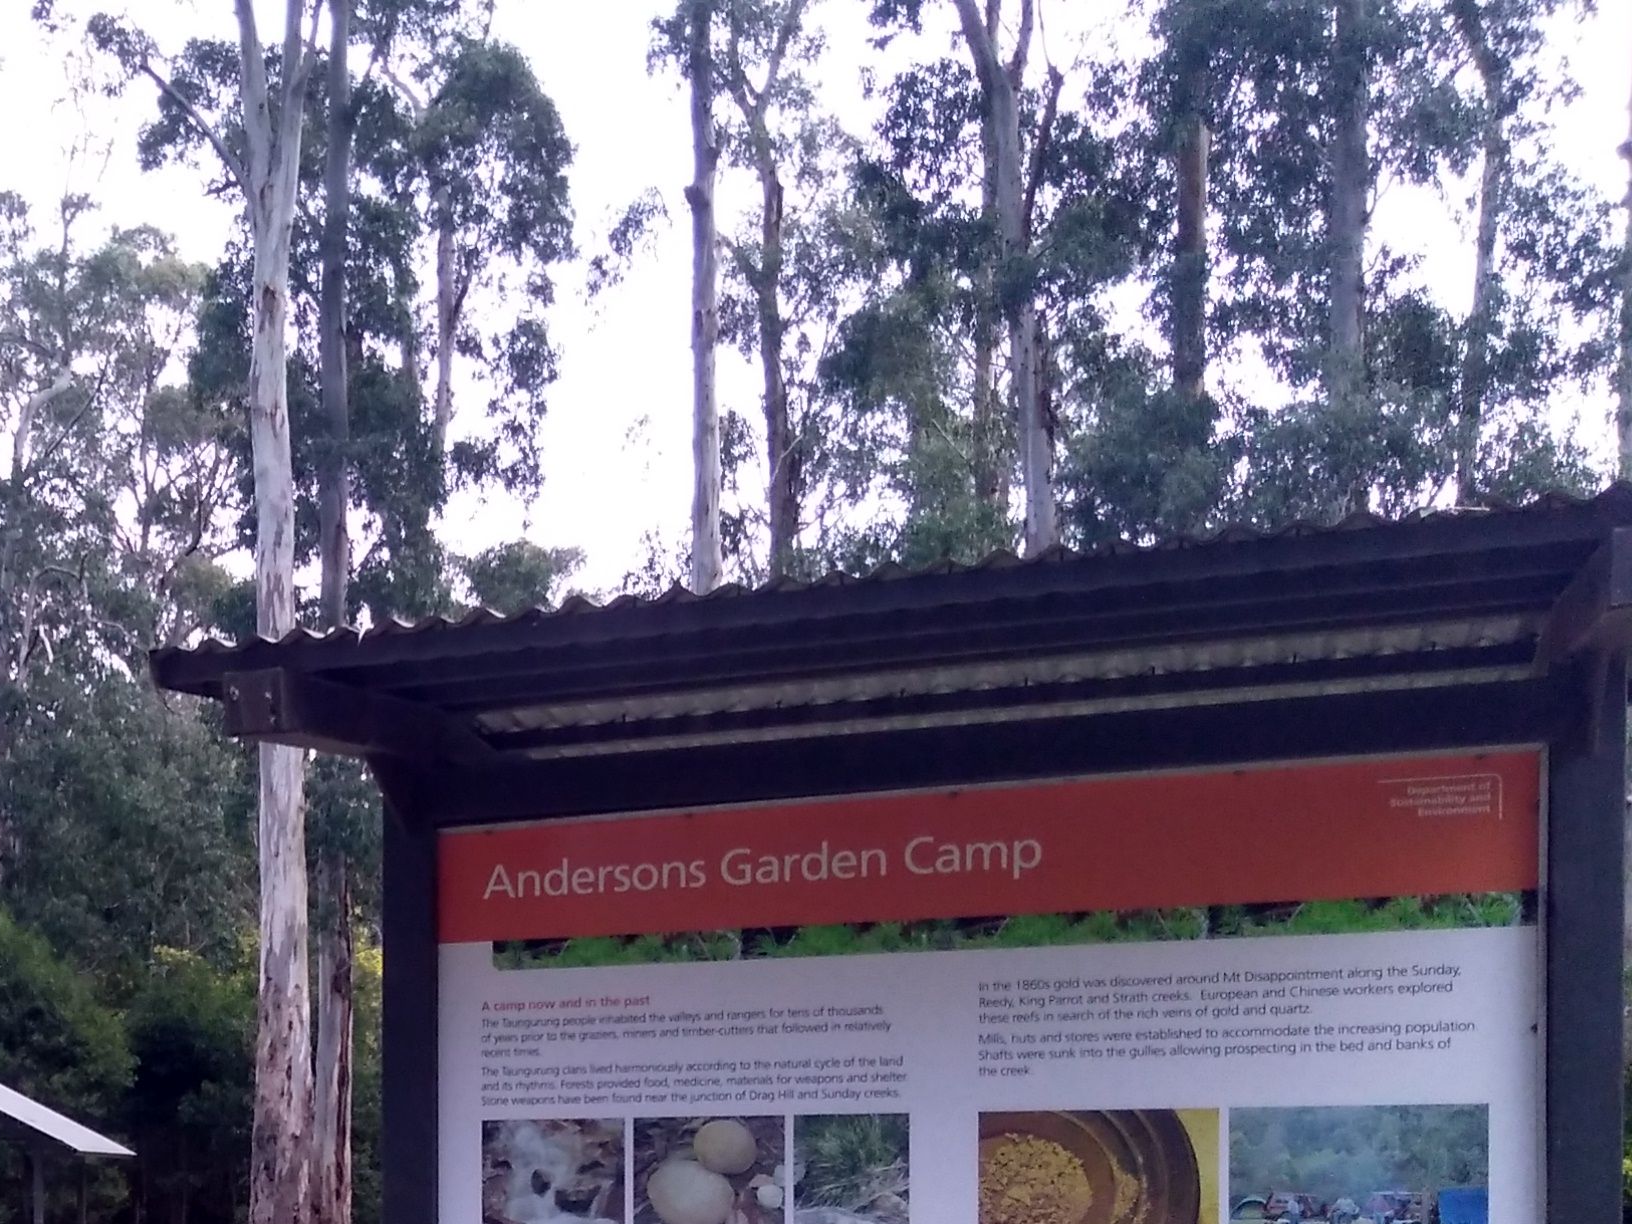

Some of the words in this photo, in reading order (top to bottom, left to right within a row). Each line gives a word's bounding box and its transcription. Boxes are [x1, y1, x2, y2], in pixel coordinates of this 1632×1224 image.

[483, 859, 706, 899] Andersons
[721, 842, 887, 885] Garden
[905, 836, 1042, 878] Camp
[993, 979, 1010, 991] the
[1017, 978, 1050, 990] 1860s
[1053, 977, 1079, 992] gold
[1083, 979, 1107, 988] was
[1110, 974, 1172, 987] discovered
[1176, 973, 1219, 985] around
[1224, 972, 1240, 983] Mt
[1245, 969, 1343, 986] Disappointment
[1347, 967, 1382, 983] along
[1388, 967, 1407, 978] the
[1019, 995, 1045, 1010] King
[1049, 994, 1082, 1005] Parrot
[1086, 993, 1109, 1004] and
[1113, 992, 1147, 1003] Strath
[1201, 988, 1258, 1004] European
[1263, 987, 1285, 999] and
[1290, 986, 1339, 998] Chinese
[1344, 984, 1394, 996] workers
[1398, 982, 1452, 998] explored
[980, 1012, 1009, 1023] these
[1013, 1011, 1040, 1022] reefs
[1044, 1010, 1053, 1021] in
[1058, 1009, 1094, 1021] search
[1098, 1009, 1110, 1020] of
[1115, 1008, 1133, 1019] the
[1138, 1008, 1158, 1019] rich
[1162, 1007, 1191, 1018] veins
[1196, 1006, 1208, 1017] of
[1243, 1005, 1266, 1016] and
[1040, 1031, 1061, 1042] and
[1065, 1030, 1098, 1042] stores
[1103, 1032, 1132, 1041] were
[1135, 1028, 1201, 1040] established
[1206, 1027, 1217, 1038] to
[1222, 1025, 1310, 1038] accommodate
[1314, 1024, 1334, 1035] the
[1338, 1023, 1401, 1038] increasing
[979, 1049, 1013, 1060] Shafts
[1017, 1051, 1044, 1059] were
[1049, 1047, 1075, 1058] sunk
[1080, 1047, 1102, 1058] into
[1107, 1046, 1125, 1057] the
[1129, 1045, 1166, 1060] gullies
[1169, 1044, 1220, 1059] allowing
[1225, 1042, 1296, 1058] prospecting
[1301, 1042, 1311, 1052] in
[1316, 1041, 1335, 1052] the
[1340, 1040, 1363, 1051] bed
[1368, 1040, 1392, 1051] and
[1396, 1039, 1433, 1050] banks
[1437, 1038, 1451, 1049] of
[979, 1065, 997, 1076] the
